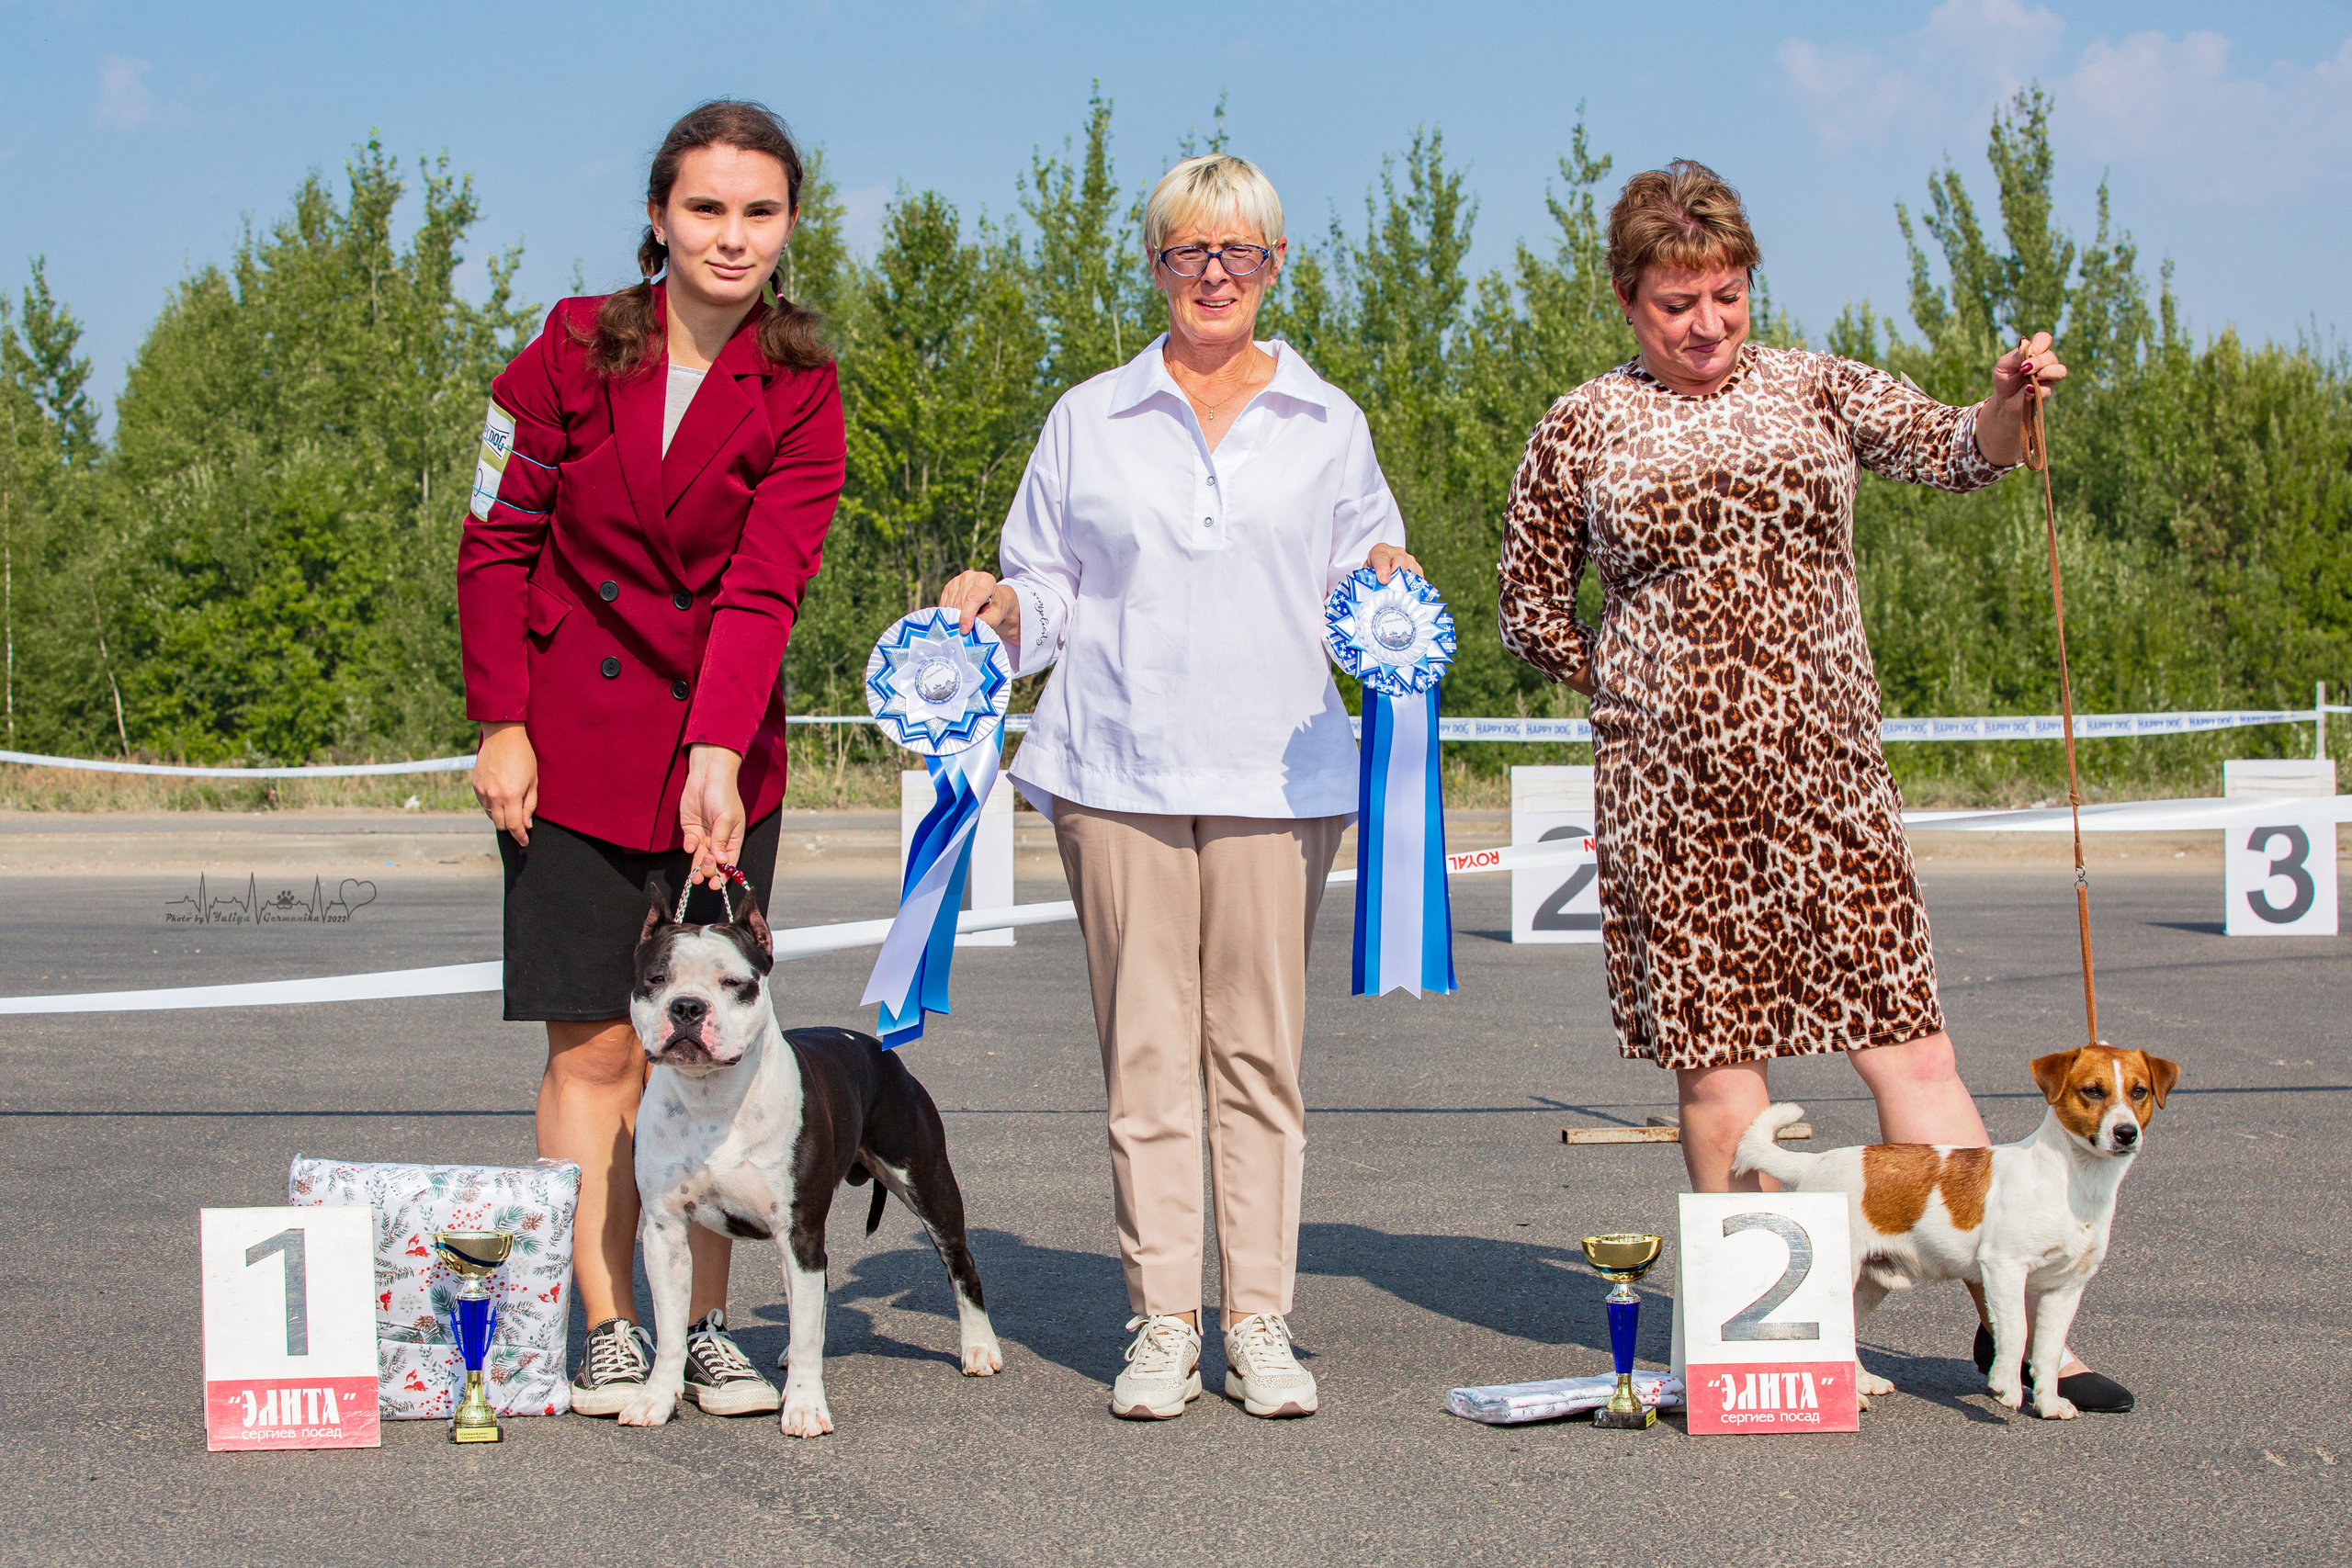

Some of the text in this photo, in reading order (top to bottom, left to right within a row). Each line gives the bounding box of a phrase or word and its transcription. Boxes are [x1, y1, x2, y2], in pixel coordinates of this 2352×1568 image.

[1452, 722, 1469, 735] DOG
[1476, 723, 1521, 736] HAPPY DOG
[1526, 723, 1553, 736] HAPPY
[1554, 723, 1571, 735] DOG
[1448, 851, 1500, 871] ROYAL
[1532, 825, 1601, 931] 2
[2246, 823, 2314, 924] 3
[1721, 1212, 1820, 1341] 2
[245, 1227, 309, 1357] 1
[1720, 1412, 1820, 1427] сергиев посад
[241, 1427, 343, 1443] сергиев посад
